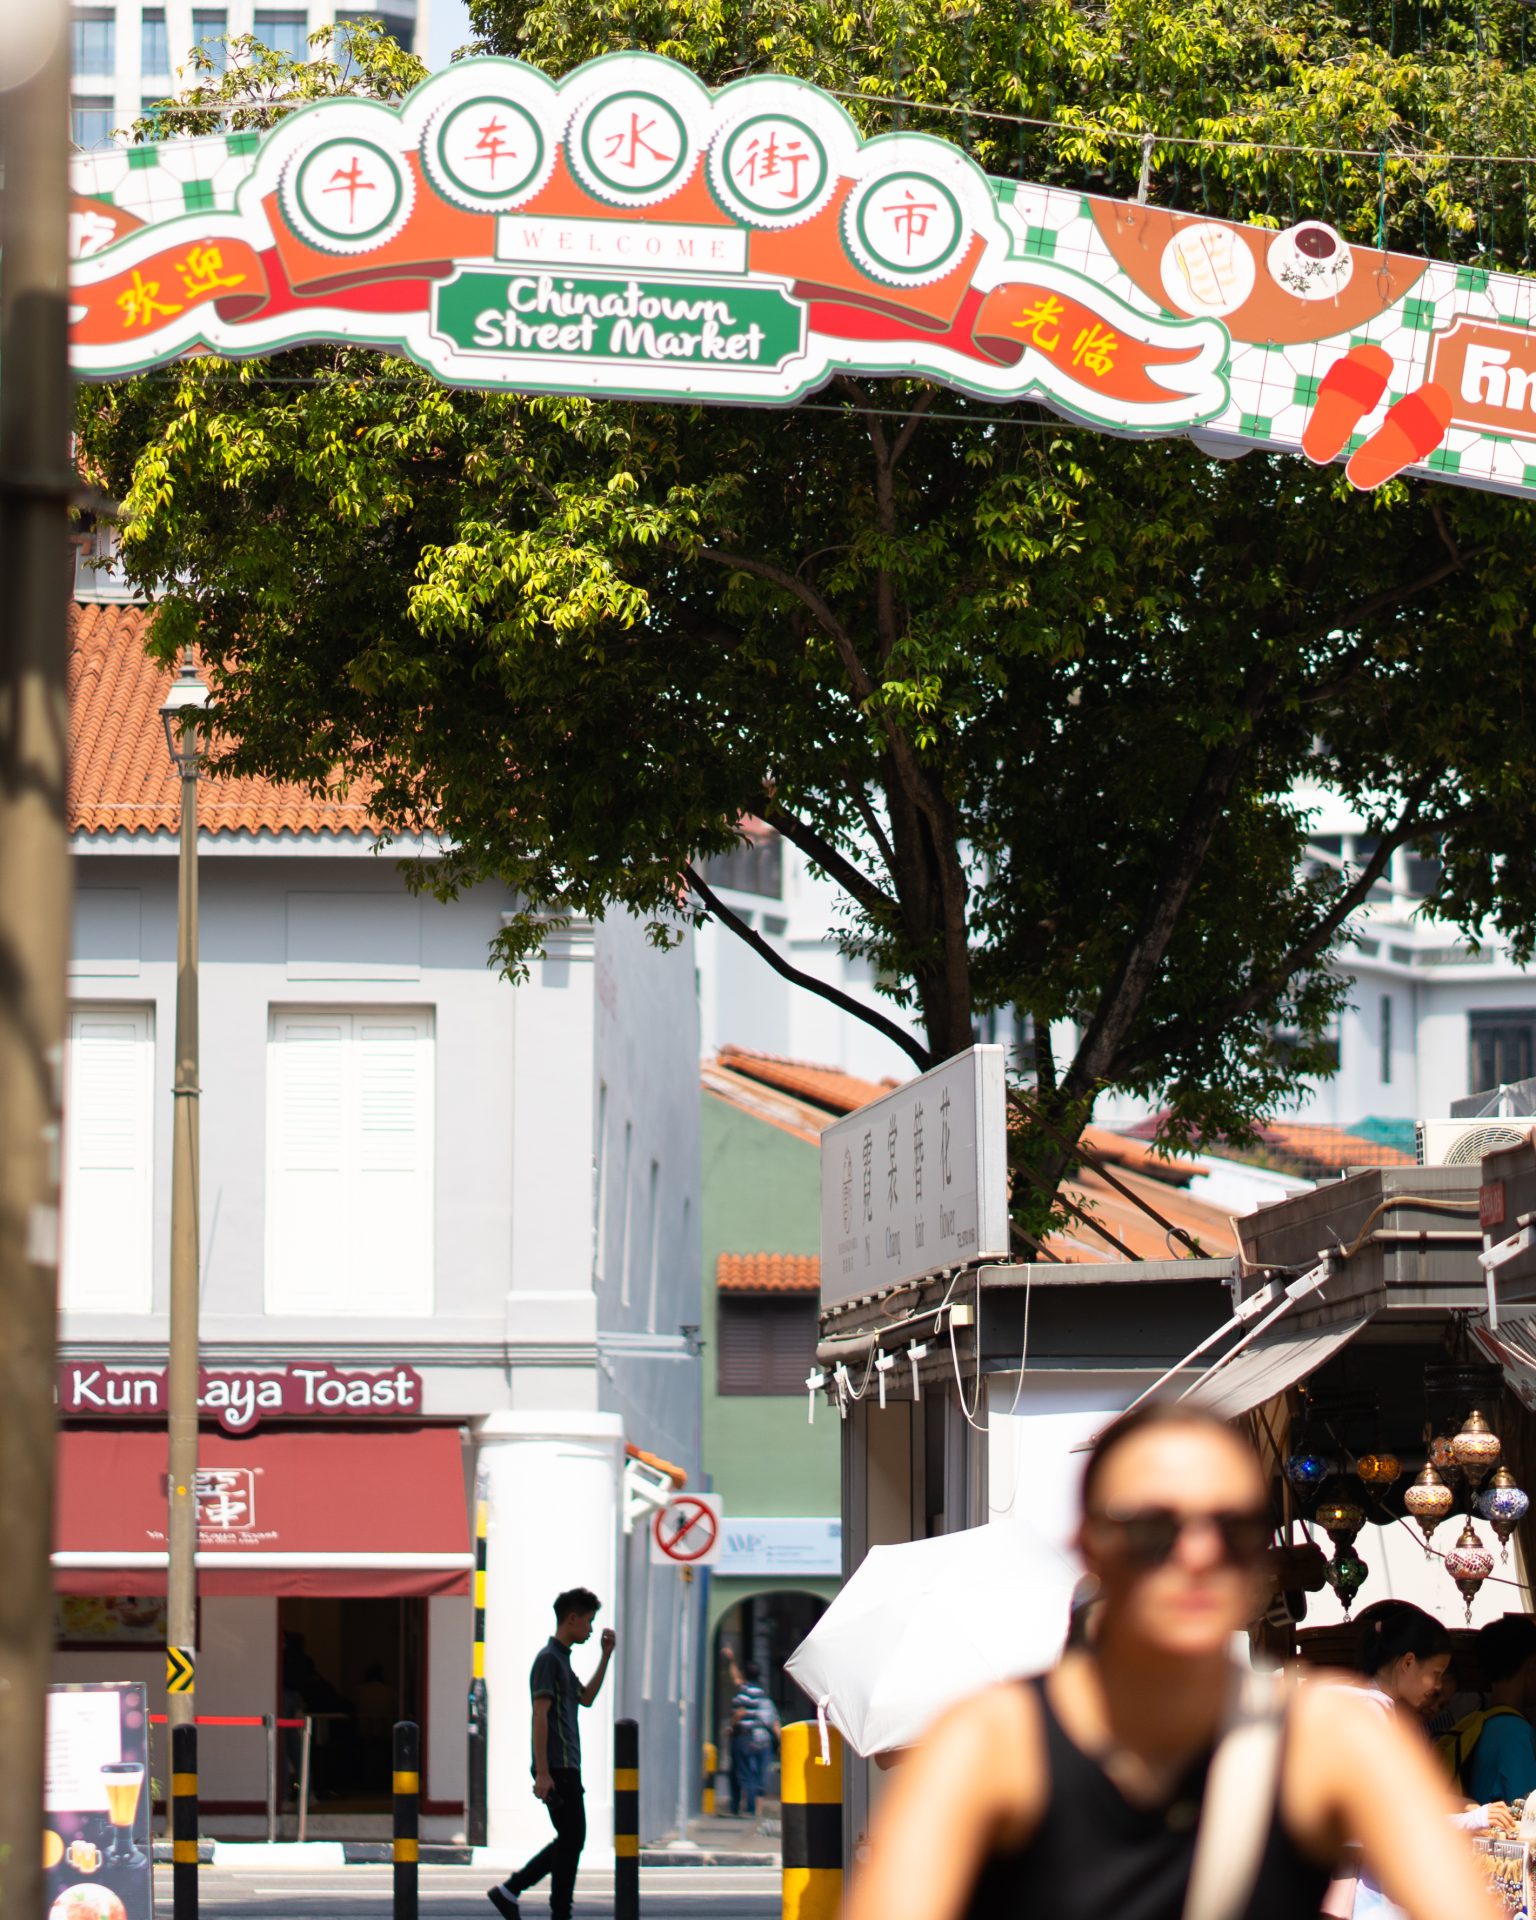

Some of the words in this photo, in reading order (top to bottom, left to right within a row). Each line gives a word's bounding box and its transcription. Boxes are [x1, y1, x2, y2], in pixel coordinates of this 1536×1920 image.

[321, 112, 938, 256] 牛车水街市
[522, 227, 726, 260] WELCOME
[116, 246, 247, 328] 欢迎
[507, 275, 738, 326] Chinatown
[472, 308, 599, 352] Street
[609, 317, 766, 361] Market
[1010, 295, 1119, 377] 光临
[72, 1370, 158, 1407] Kun
[196, 1379, 283, 1426] aya
[292, 1369, 415, 1407] Toast
